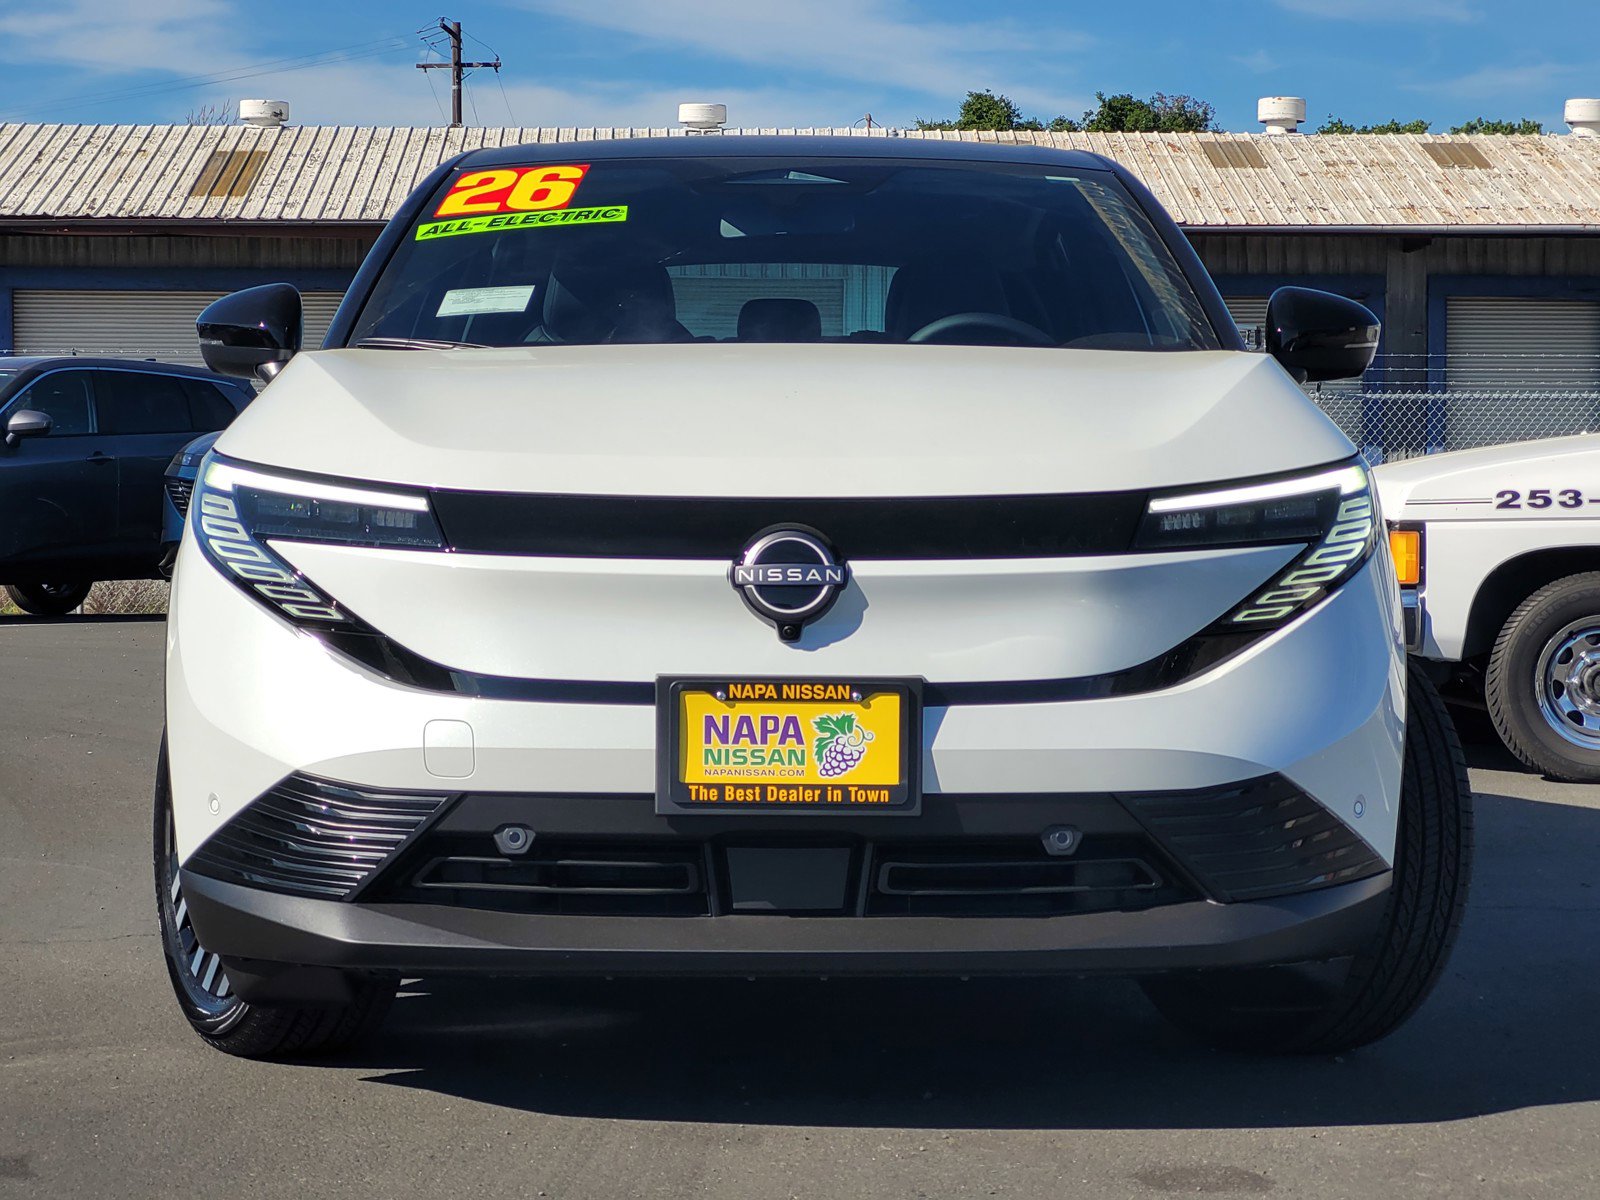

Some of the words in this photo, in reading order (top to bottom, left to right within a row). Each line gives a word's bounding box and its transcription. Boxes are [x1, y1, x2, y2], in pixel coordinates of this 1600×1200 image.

[436, 166, 583, 216] 26
[420, 207, 624, 237] ALL-ELECTRIC
[738, 568, 841, 582] NISSAN
[728, 683, 778, 700] NAPA
[782, 684, 851, 700] NISSAN
[704, 715, 805, 745] NAPA
[704, 748, 806, 766] NISSAN
[704, 768, 805, 777] NAPANISSAN.COM
[688, 784, 719, 802] The
[724, 785, 761, 803] Best
[767, 786, 822, 803] Dealer
[827, 785, 843, 803] in
[848, 786, 890, 803] Town
